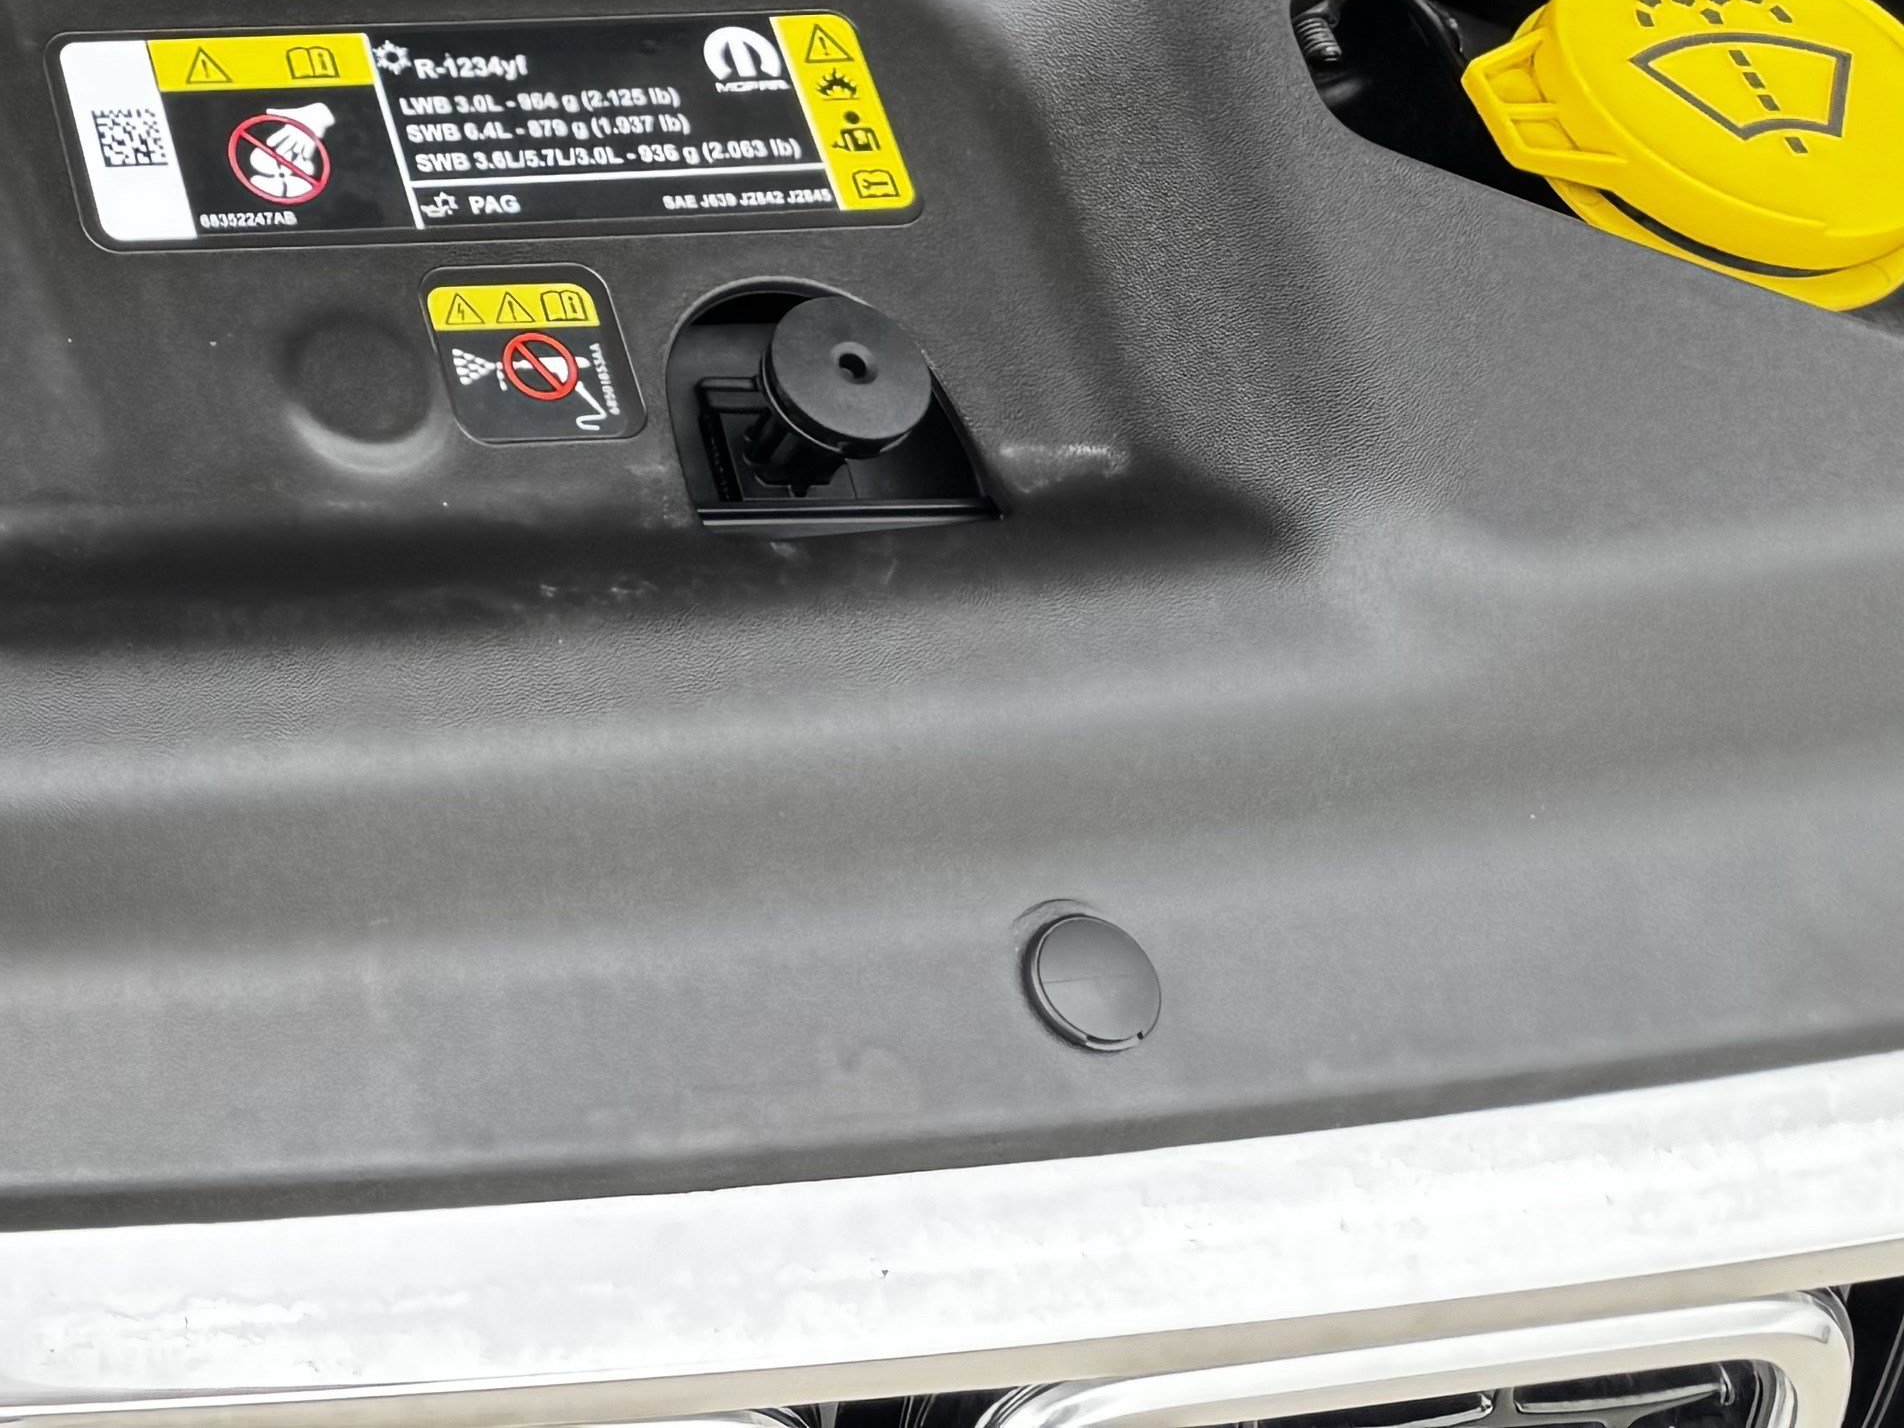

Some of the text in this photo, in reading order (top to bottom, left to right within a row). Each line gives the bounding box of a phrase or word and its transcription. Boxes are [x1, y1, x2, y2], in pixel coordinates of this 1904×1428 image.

[414, 53, 528, 82] R-1234yf
[399, 96, 453, 116] LWB
[454, 94, 505, 114] 3.0L
[581, 87, 647, 112] (2.125
[648, 86, 682, 108] lb)
[406, 122, 462, 143] SWB
[658, 113, 691, 135] lb)
[415, 153, 472, 172] SWB
[473, 145, 624, 170] 3.6L/5.7L/3.0L
[638, 144, 681, 163] 936
[769, 138, 803, 160] lb)
[468, 193, 521, 215] PAG
[662, 195, 698, 210] SAE
